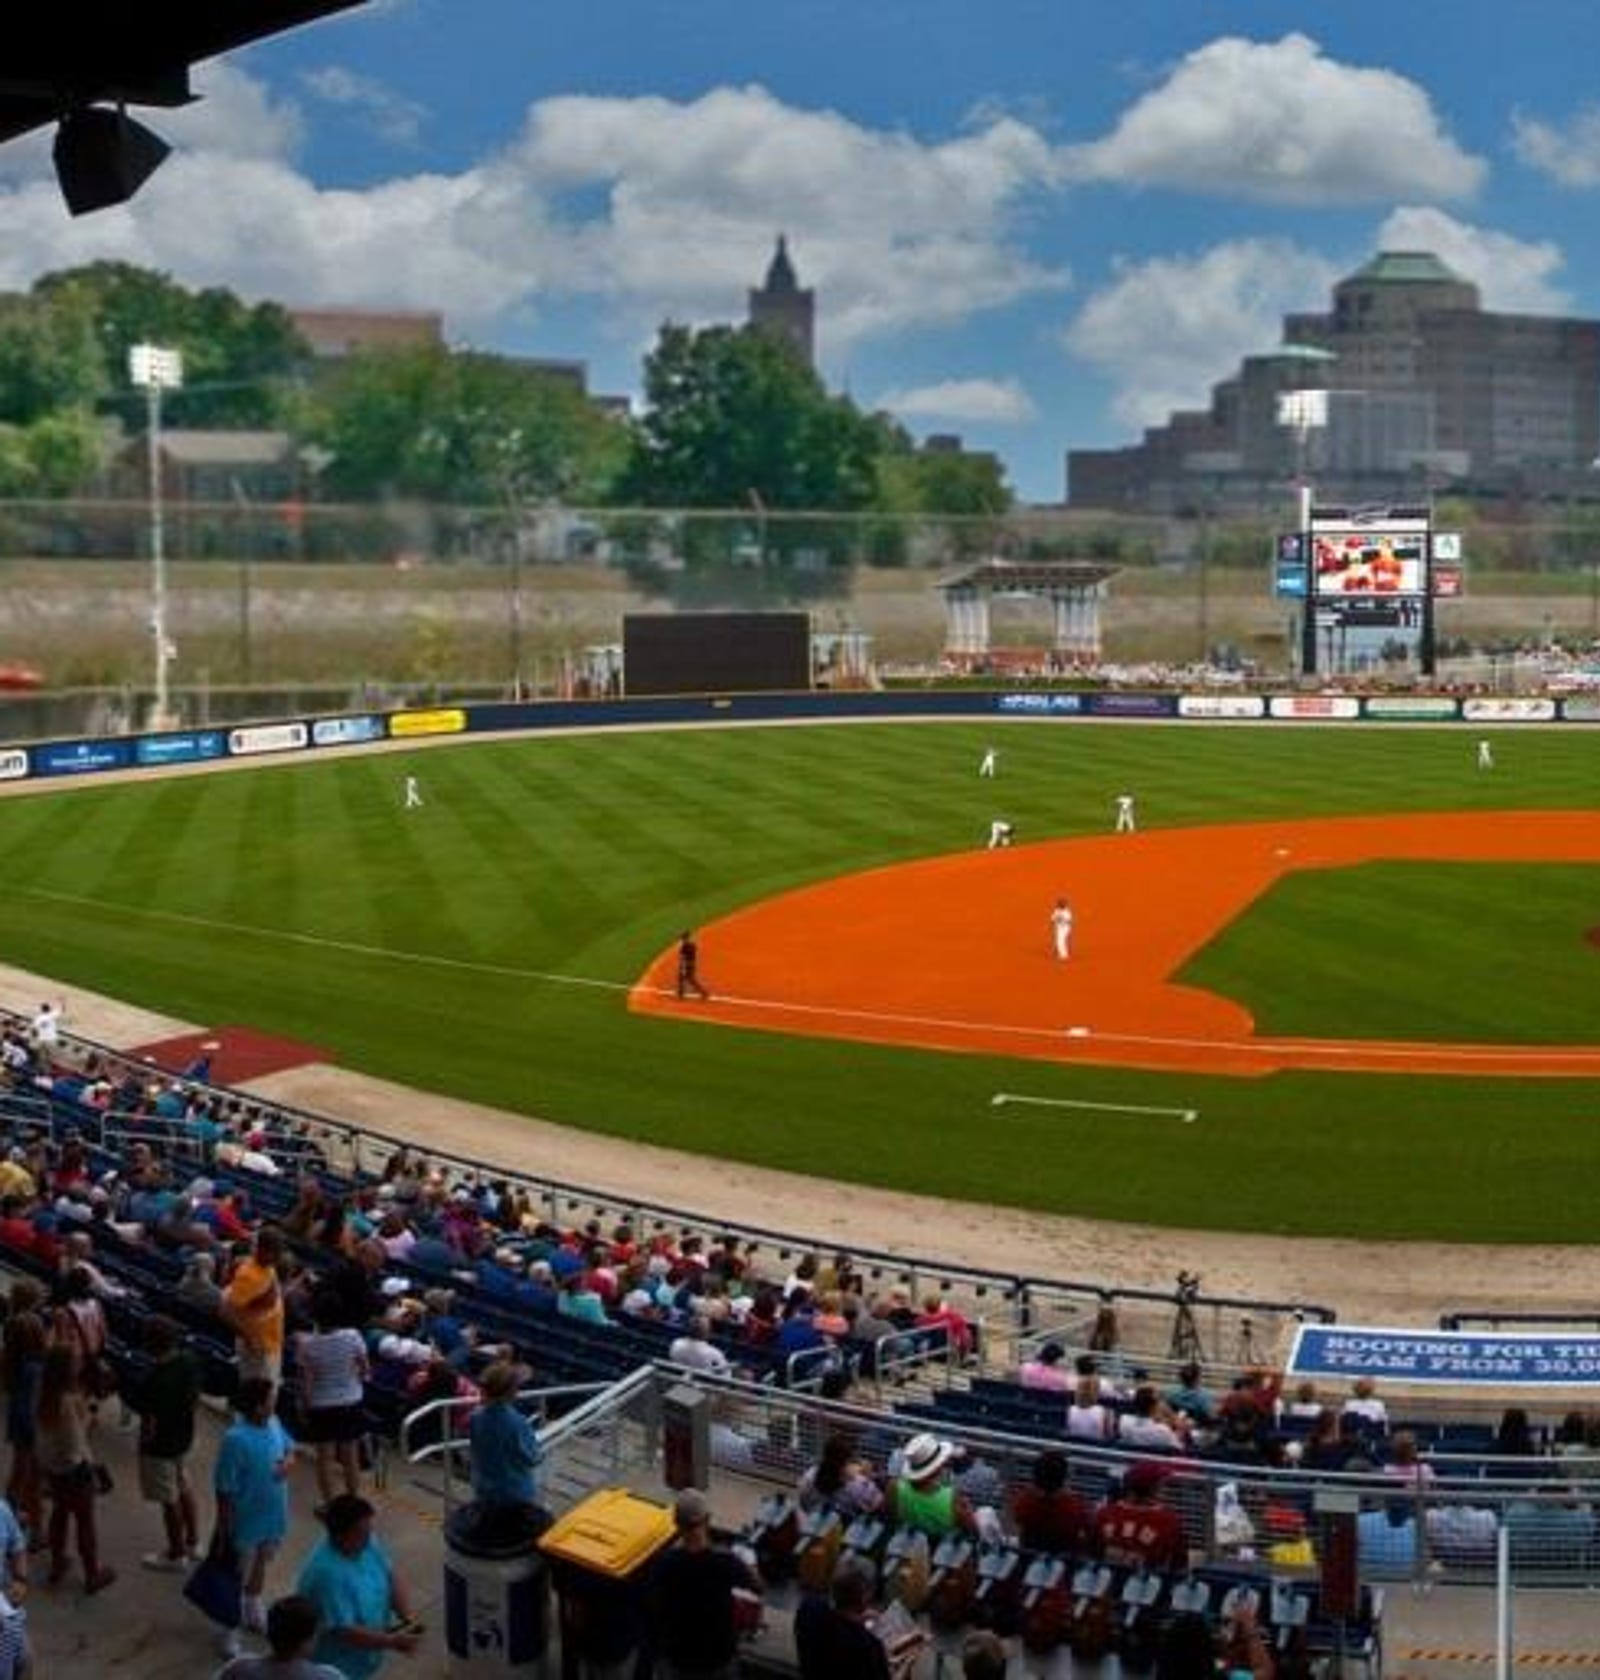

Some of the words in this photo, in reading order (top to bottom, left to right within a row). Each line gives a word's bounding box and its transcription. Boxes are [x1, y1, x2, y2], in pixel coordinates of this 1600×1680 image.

[1325, 1337, 1470, 1354] ROOTING
[1482, 1343, 1545, 1357] FOR
[1321, 1350, 1417, 1369] TEAM
[1430, 1356, 1523, 1372] FROM
